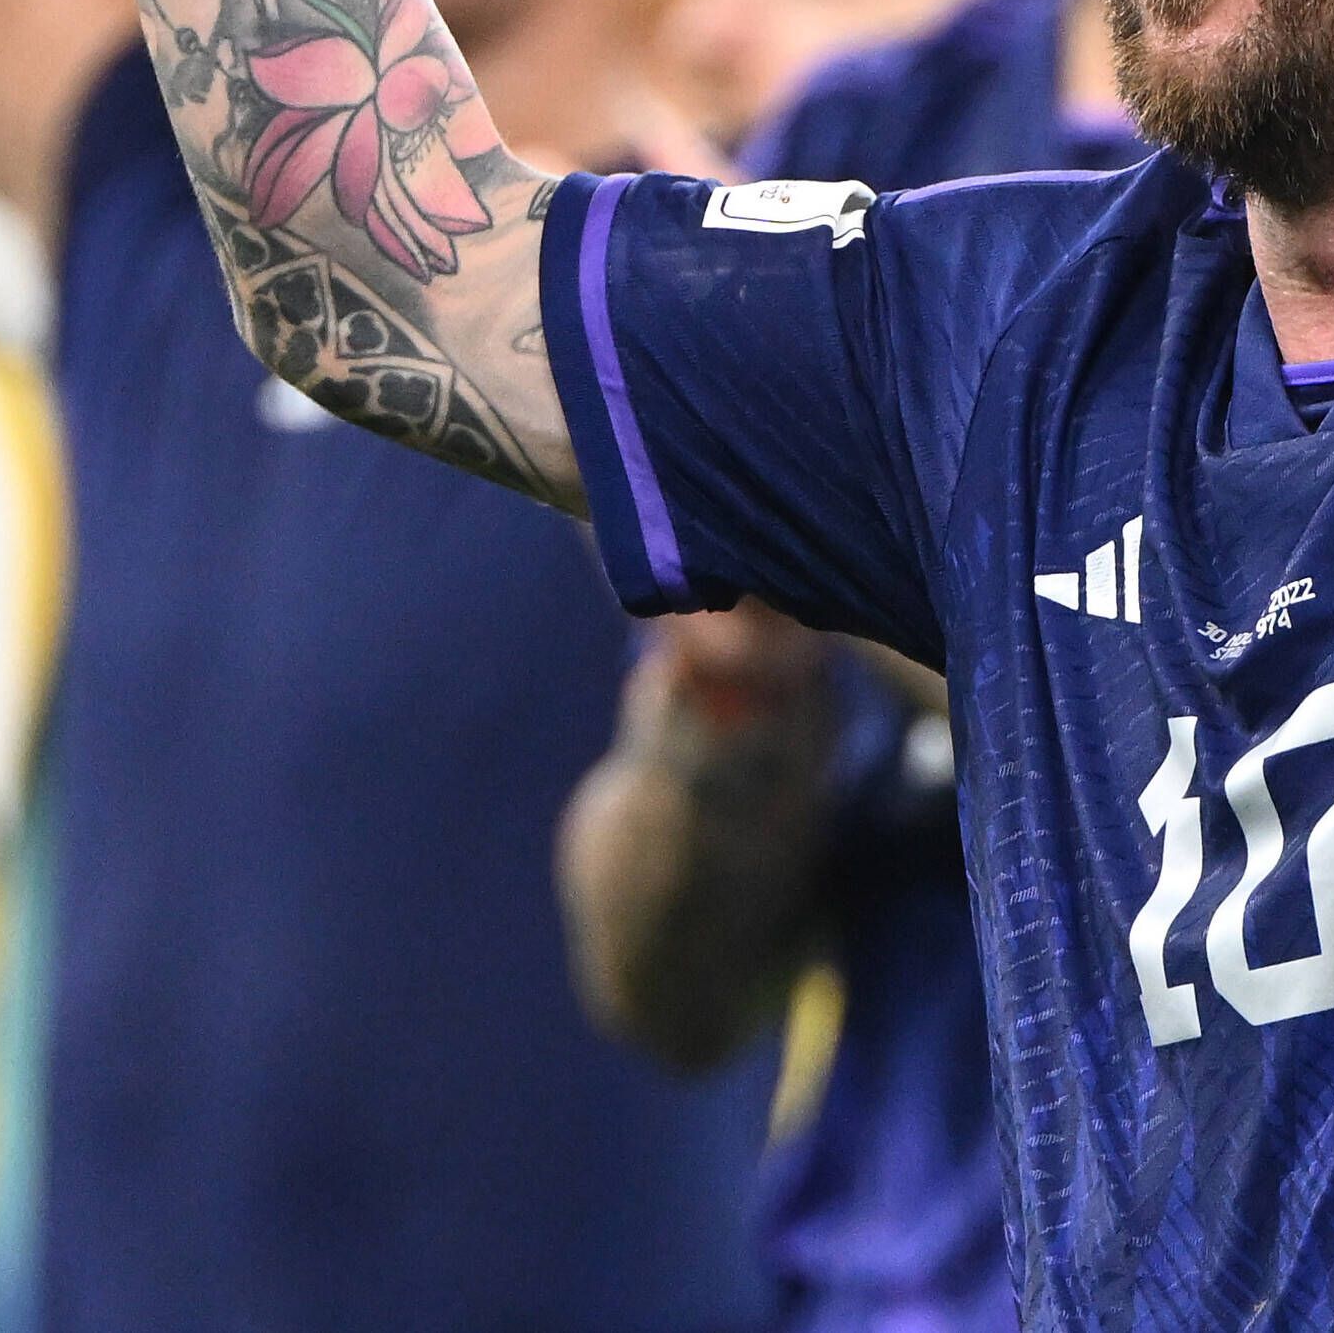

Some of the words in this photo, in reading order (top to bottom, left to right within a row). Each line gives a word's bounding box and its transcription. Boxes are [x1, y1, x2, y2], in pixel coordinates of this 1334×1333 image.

[1197, 621, 1228, 643] 30
[1268, 577, 1316, 613] 2022
[1255, 608, 1292, 639] 974
